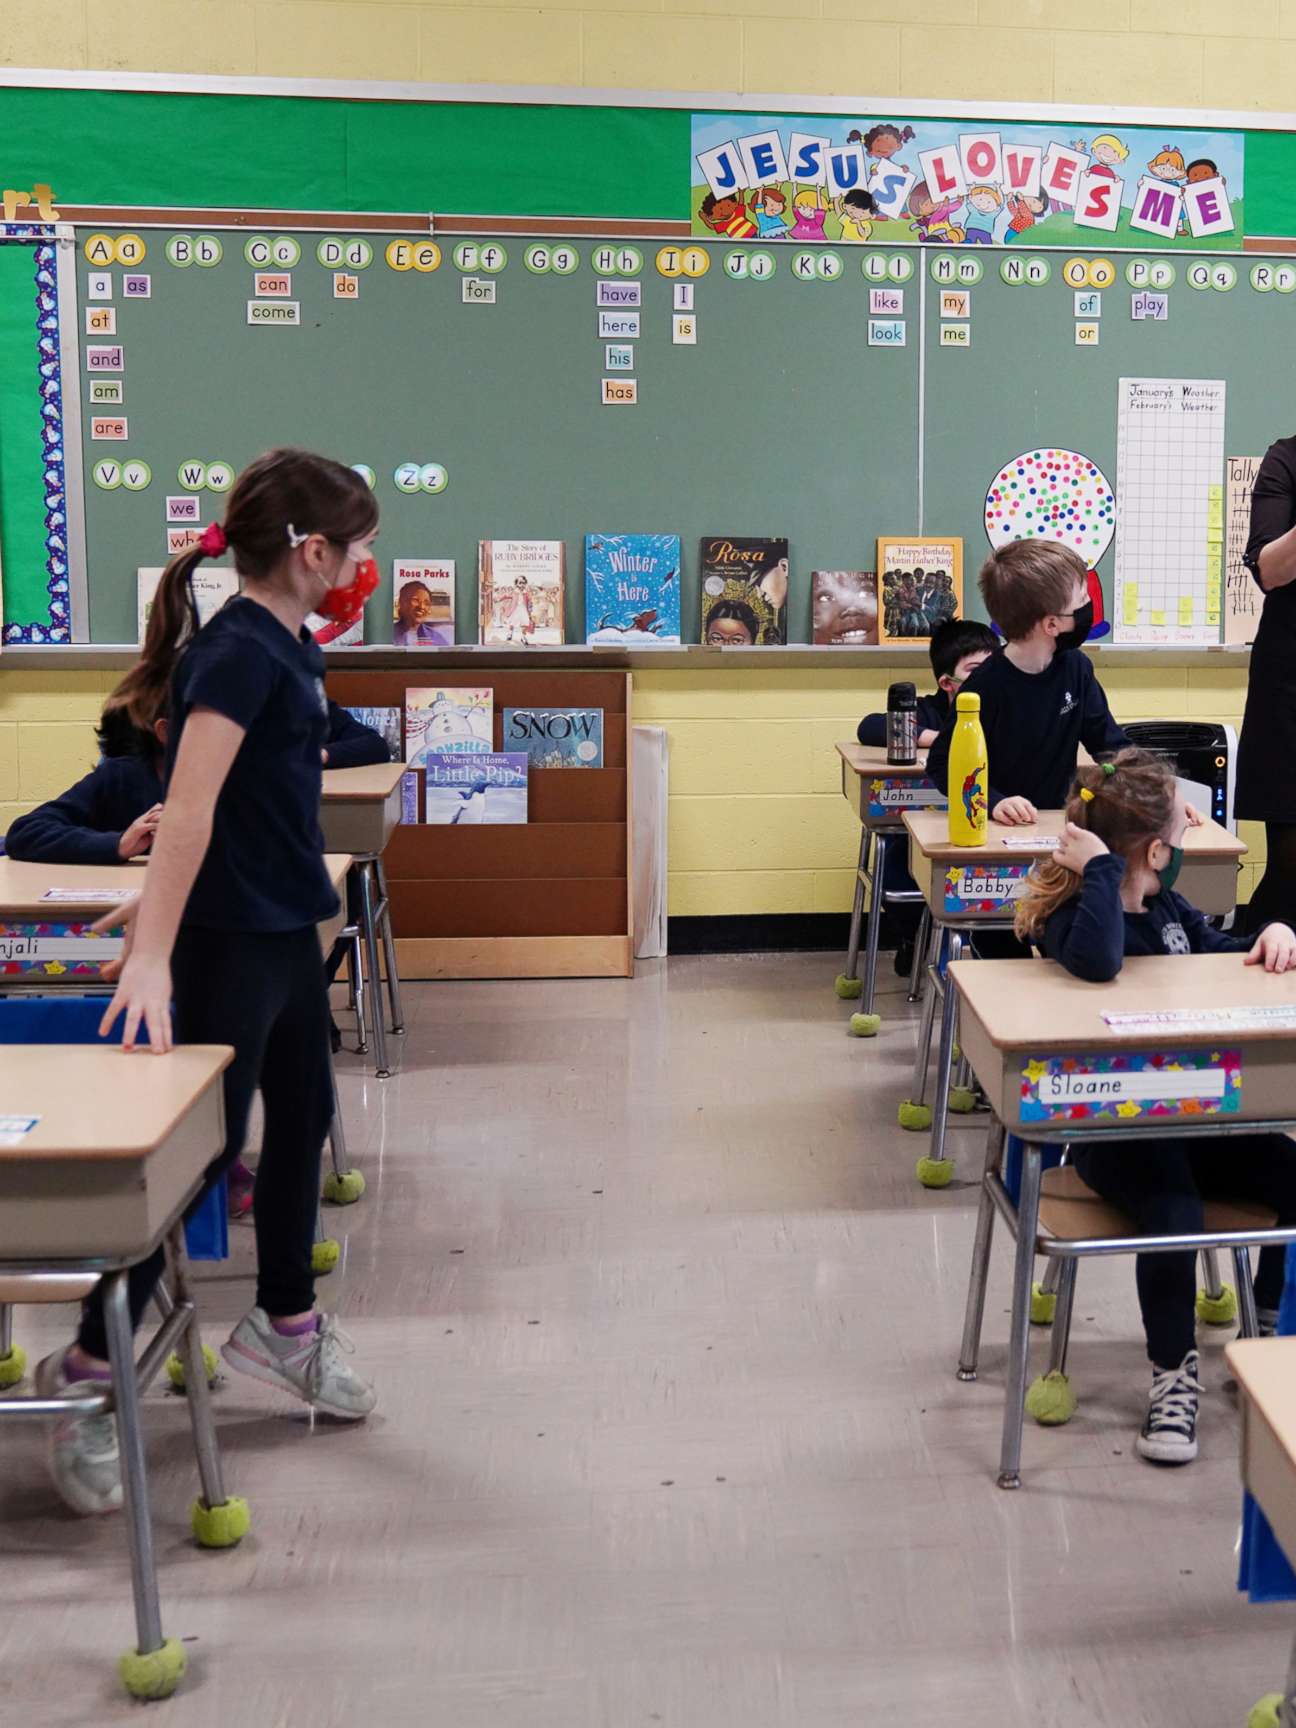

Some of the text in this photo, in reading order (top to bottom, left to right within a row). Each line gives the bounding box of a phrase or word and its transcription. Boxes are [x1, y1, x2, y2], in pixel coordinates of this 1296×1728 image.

[714, 140, 1222, 228] JESUS LOVES ME
[96, 280, 105, 291] a
[127, 280, 147, 292] as
[258, 280, 288, 291] can
[336, 275, 356, 293] do
[466, 279, 492, 298] for
[600, 282, 638, 302] have
[679, 285, 687, 303] I
[873, 292, 899, 309] like
[252, 306, 296, 319] come
[943, 296, 966, 315] my
[1079, 295, 1098, 312] of
[1134, 295, 1164, 318] play
[91, 312, 110, 328] at
[602, 313, 638, 333] here
[678, 319, 692, 335] is
[870, 322, 902, 340] look
[943, 328, 966, 341] me
[1078, 327, 1096, 340] or
[90, 348, 121, 366] and
[608, 346, 632, 365] his
[93, 387, 119, 398] am
[605, 381, 634, 399] has
[95, 423, 123, 434] are
[171, 504, 195, 514] we
[705, 540, 766, 564] Rosa
[607, 549, 658, 574] Winter
[399, 567, 450, 579] Rosa Parks
[616, 584, 650, 602] Here
[509, 710, 599, 740] SNOW
[441, 754, 471, 765] Where
[431, 764, 522, 785] Little Pip?
[882, 788, 914, 802] John
[962, 877, 1015, 898] Bobby
[1050, 1072, 1123, 1097] Sloane
